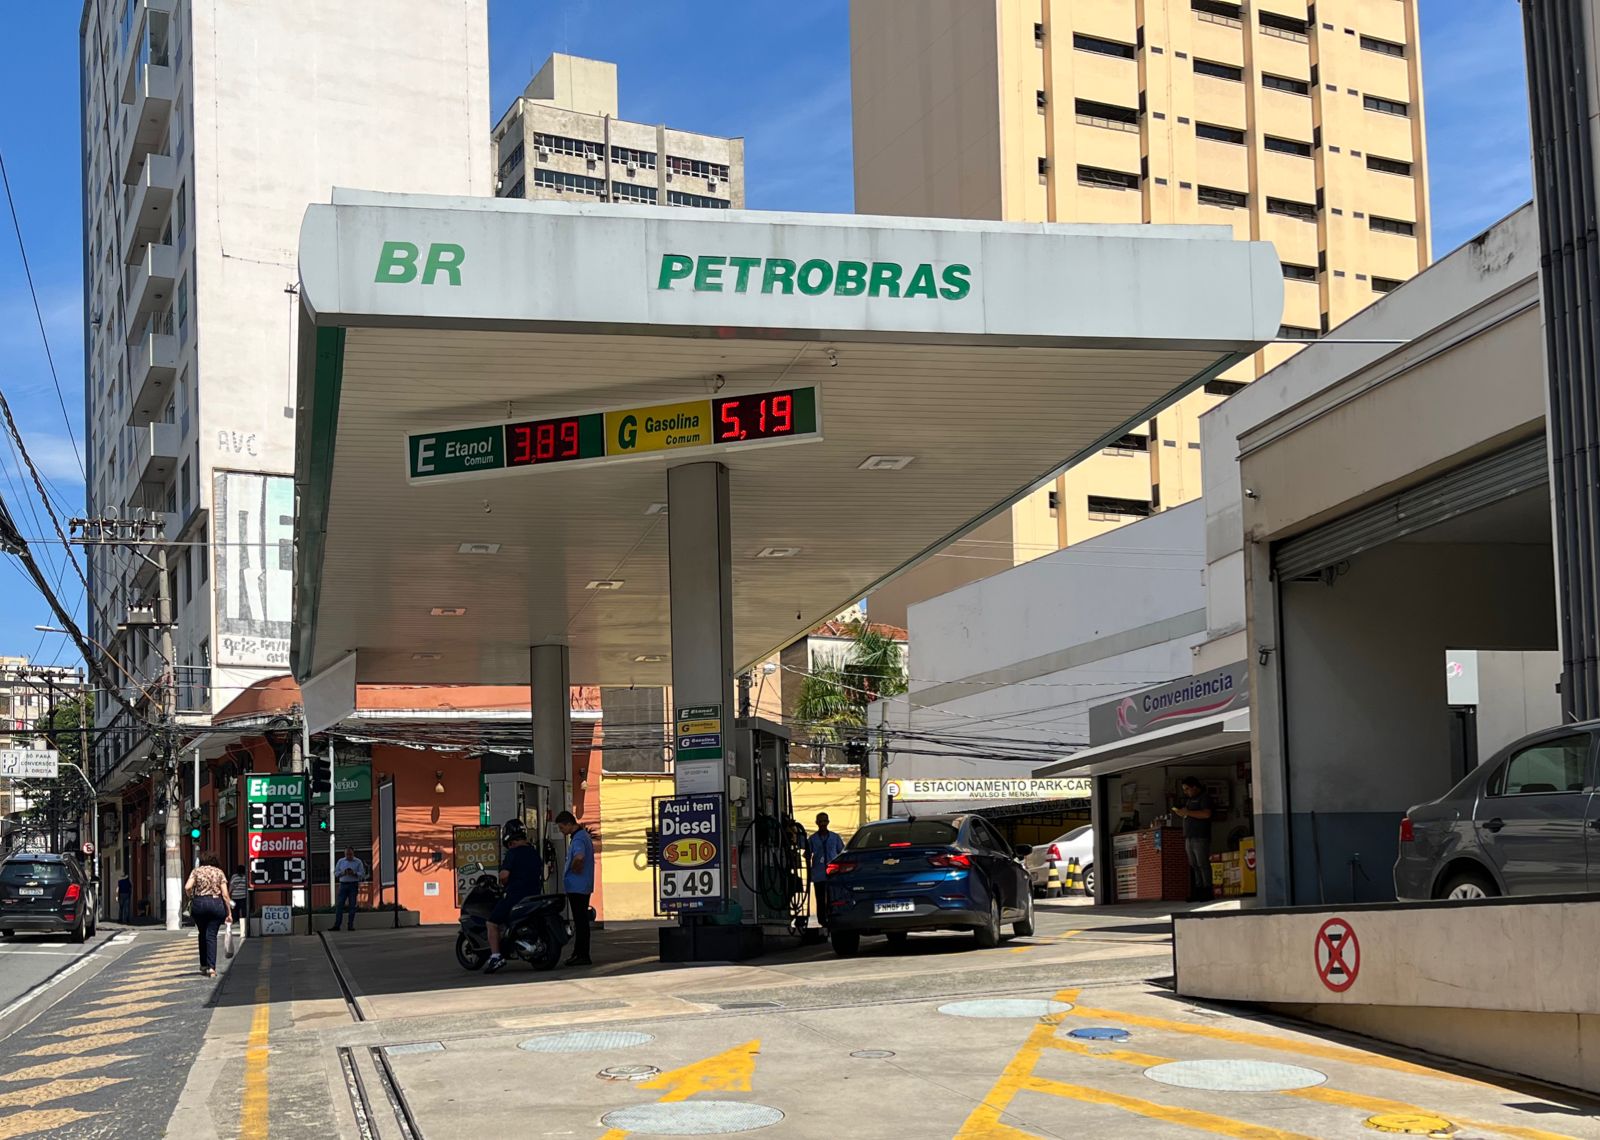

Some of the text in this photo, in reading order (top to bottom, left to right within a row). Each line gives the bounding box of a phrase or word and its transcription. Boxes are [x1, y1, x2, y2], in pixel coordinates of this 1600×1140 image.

[374, 241, 971, 301] BR PETROBRAS
[722, 395, 791, 439] 5,19
[618, 413, 699, 449] G Gasolina
[666, 433, 700, 446] Comum
[514, 422, 578, 464] 3,89
[417, 437, 492, 472] E Etanol
[464, 455, 494, 467] Comum
[1143, 673, 1233, 713] Conveniência
[681, 738, 690, 748] G
[250, 778, 302, 796] Etanol
[914, 780, 1092, 792] ESTACIONAMENTO PARK-CAR
[252, 803, 304, 829] 3,89
[664, 801, 713, 816] Aqui tem
[662, 814, 716, 836] Diesel
[251, 835, 304, 852] Gasolina
[459, 843, 494, 852] TROCA
[666, 841, 714, 863] S-10
[251, 858, 305, 884] 5,19
[264, 912, 290, 920] GELO
